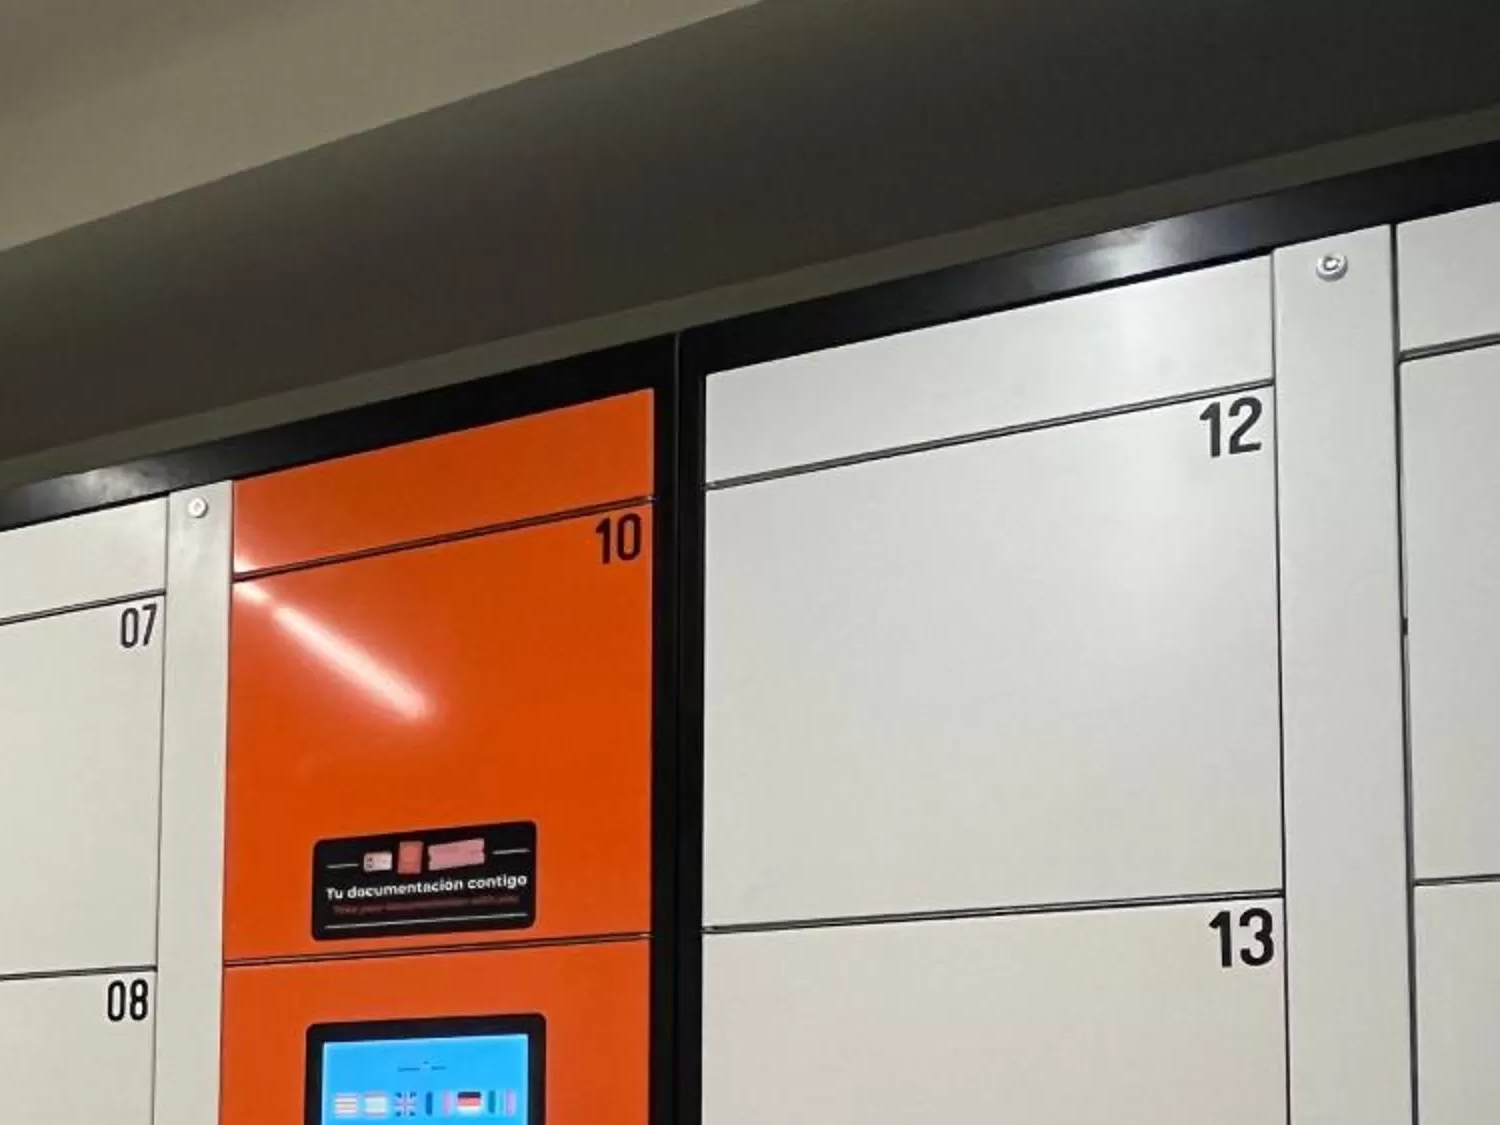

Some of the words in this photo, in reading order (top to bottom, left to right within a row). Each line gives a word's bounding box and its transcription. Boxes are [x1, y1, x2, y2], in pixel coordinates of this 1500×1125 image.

[1200, 397, 1262, 457] 12
[596, 513, 642, 563] 10
[120, 603, 157, 648] 07
[325, 886, 344, 901] Tu
[467, 873, 528, 891] contigo
[1209, 908, 1274, 968] 13
[108, 979, 148, 1022] 08
